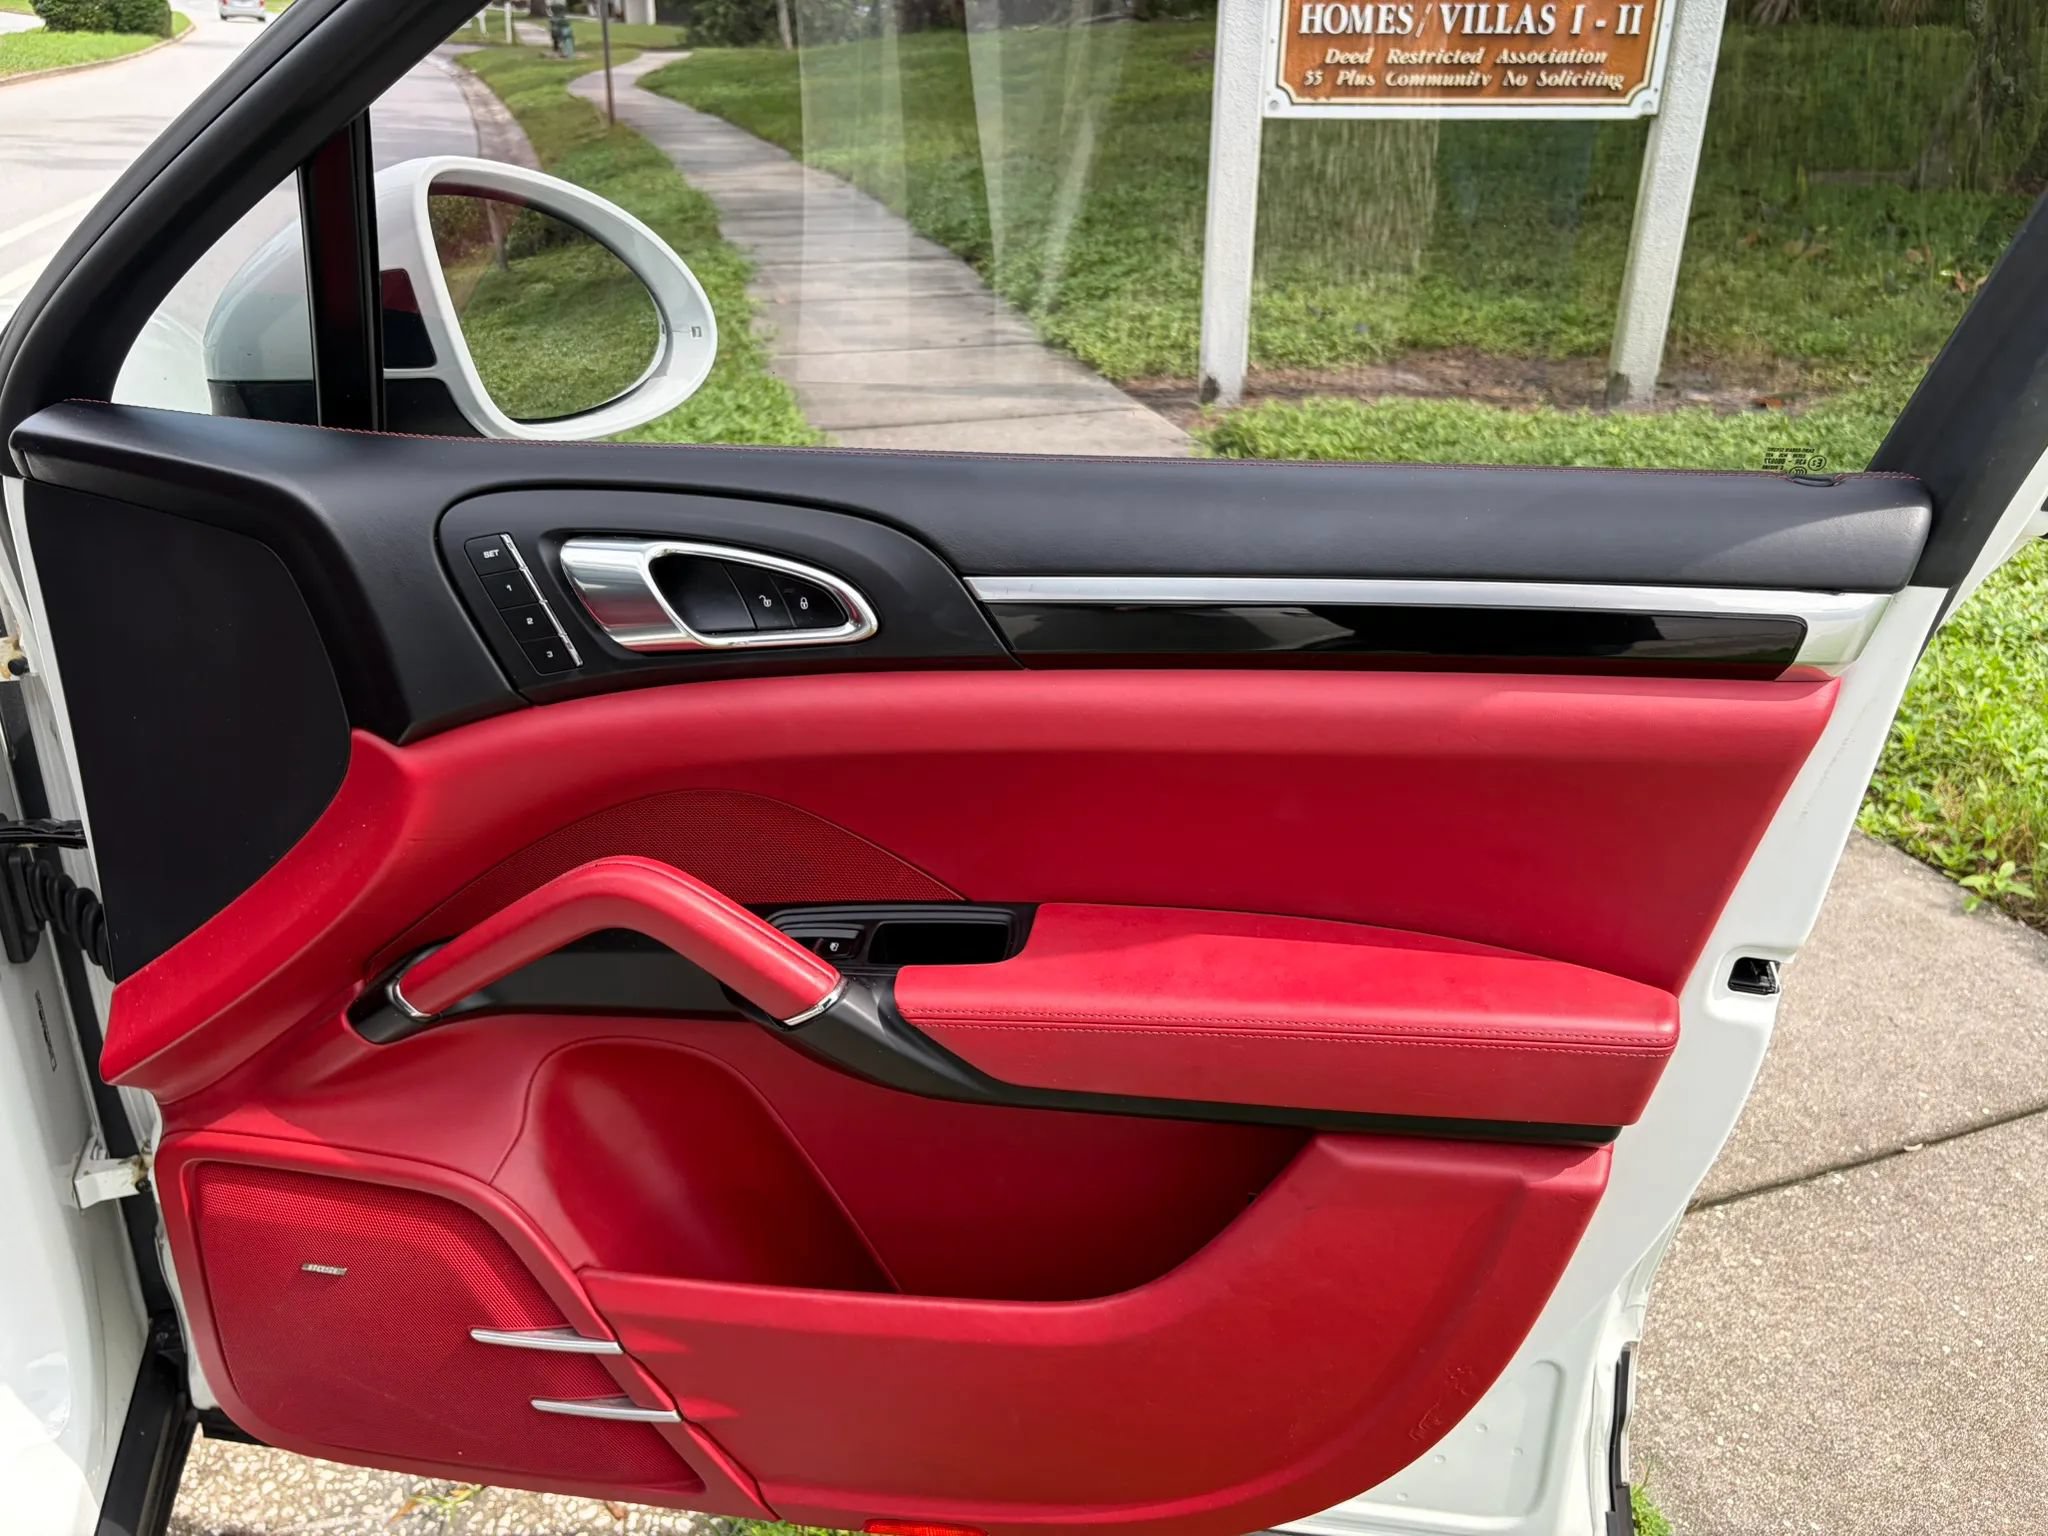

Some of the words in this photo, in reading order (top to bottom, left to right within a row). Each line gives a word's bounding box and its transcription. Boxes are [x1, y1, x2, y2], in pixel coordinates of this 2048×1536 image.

[1570, 4, 1586, 34] I
[1615, 4, 1644, 35] II
[1324, 47, 1375, 64] Deed
[1387, 46, 1486, 64] Restricted
[1496, 48, 1608, 64] Association
[1304, 69, 1324, 86] 55
[1336, 69, 1376, 86] Plus
[1385, 69, 1493, 87] Community
[1503, 70, 1529, 87] No
[1536, 69, 1625, 91] Soliciting
[483, 549, 500, 559] SET
[506, 584, 513, 592] 1
[526, 617, 534, 625] 2
[546, 650, 554, 658] 3
